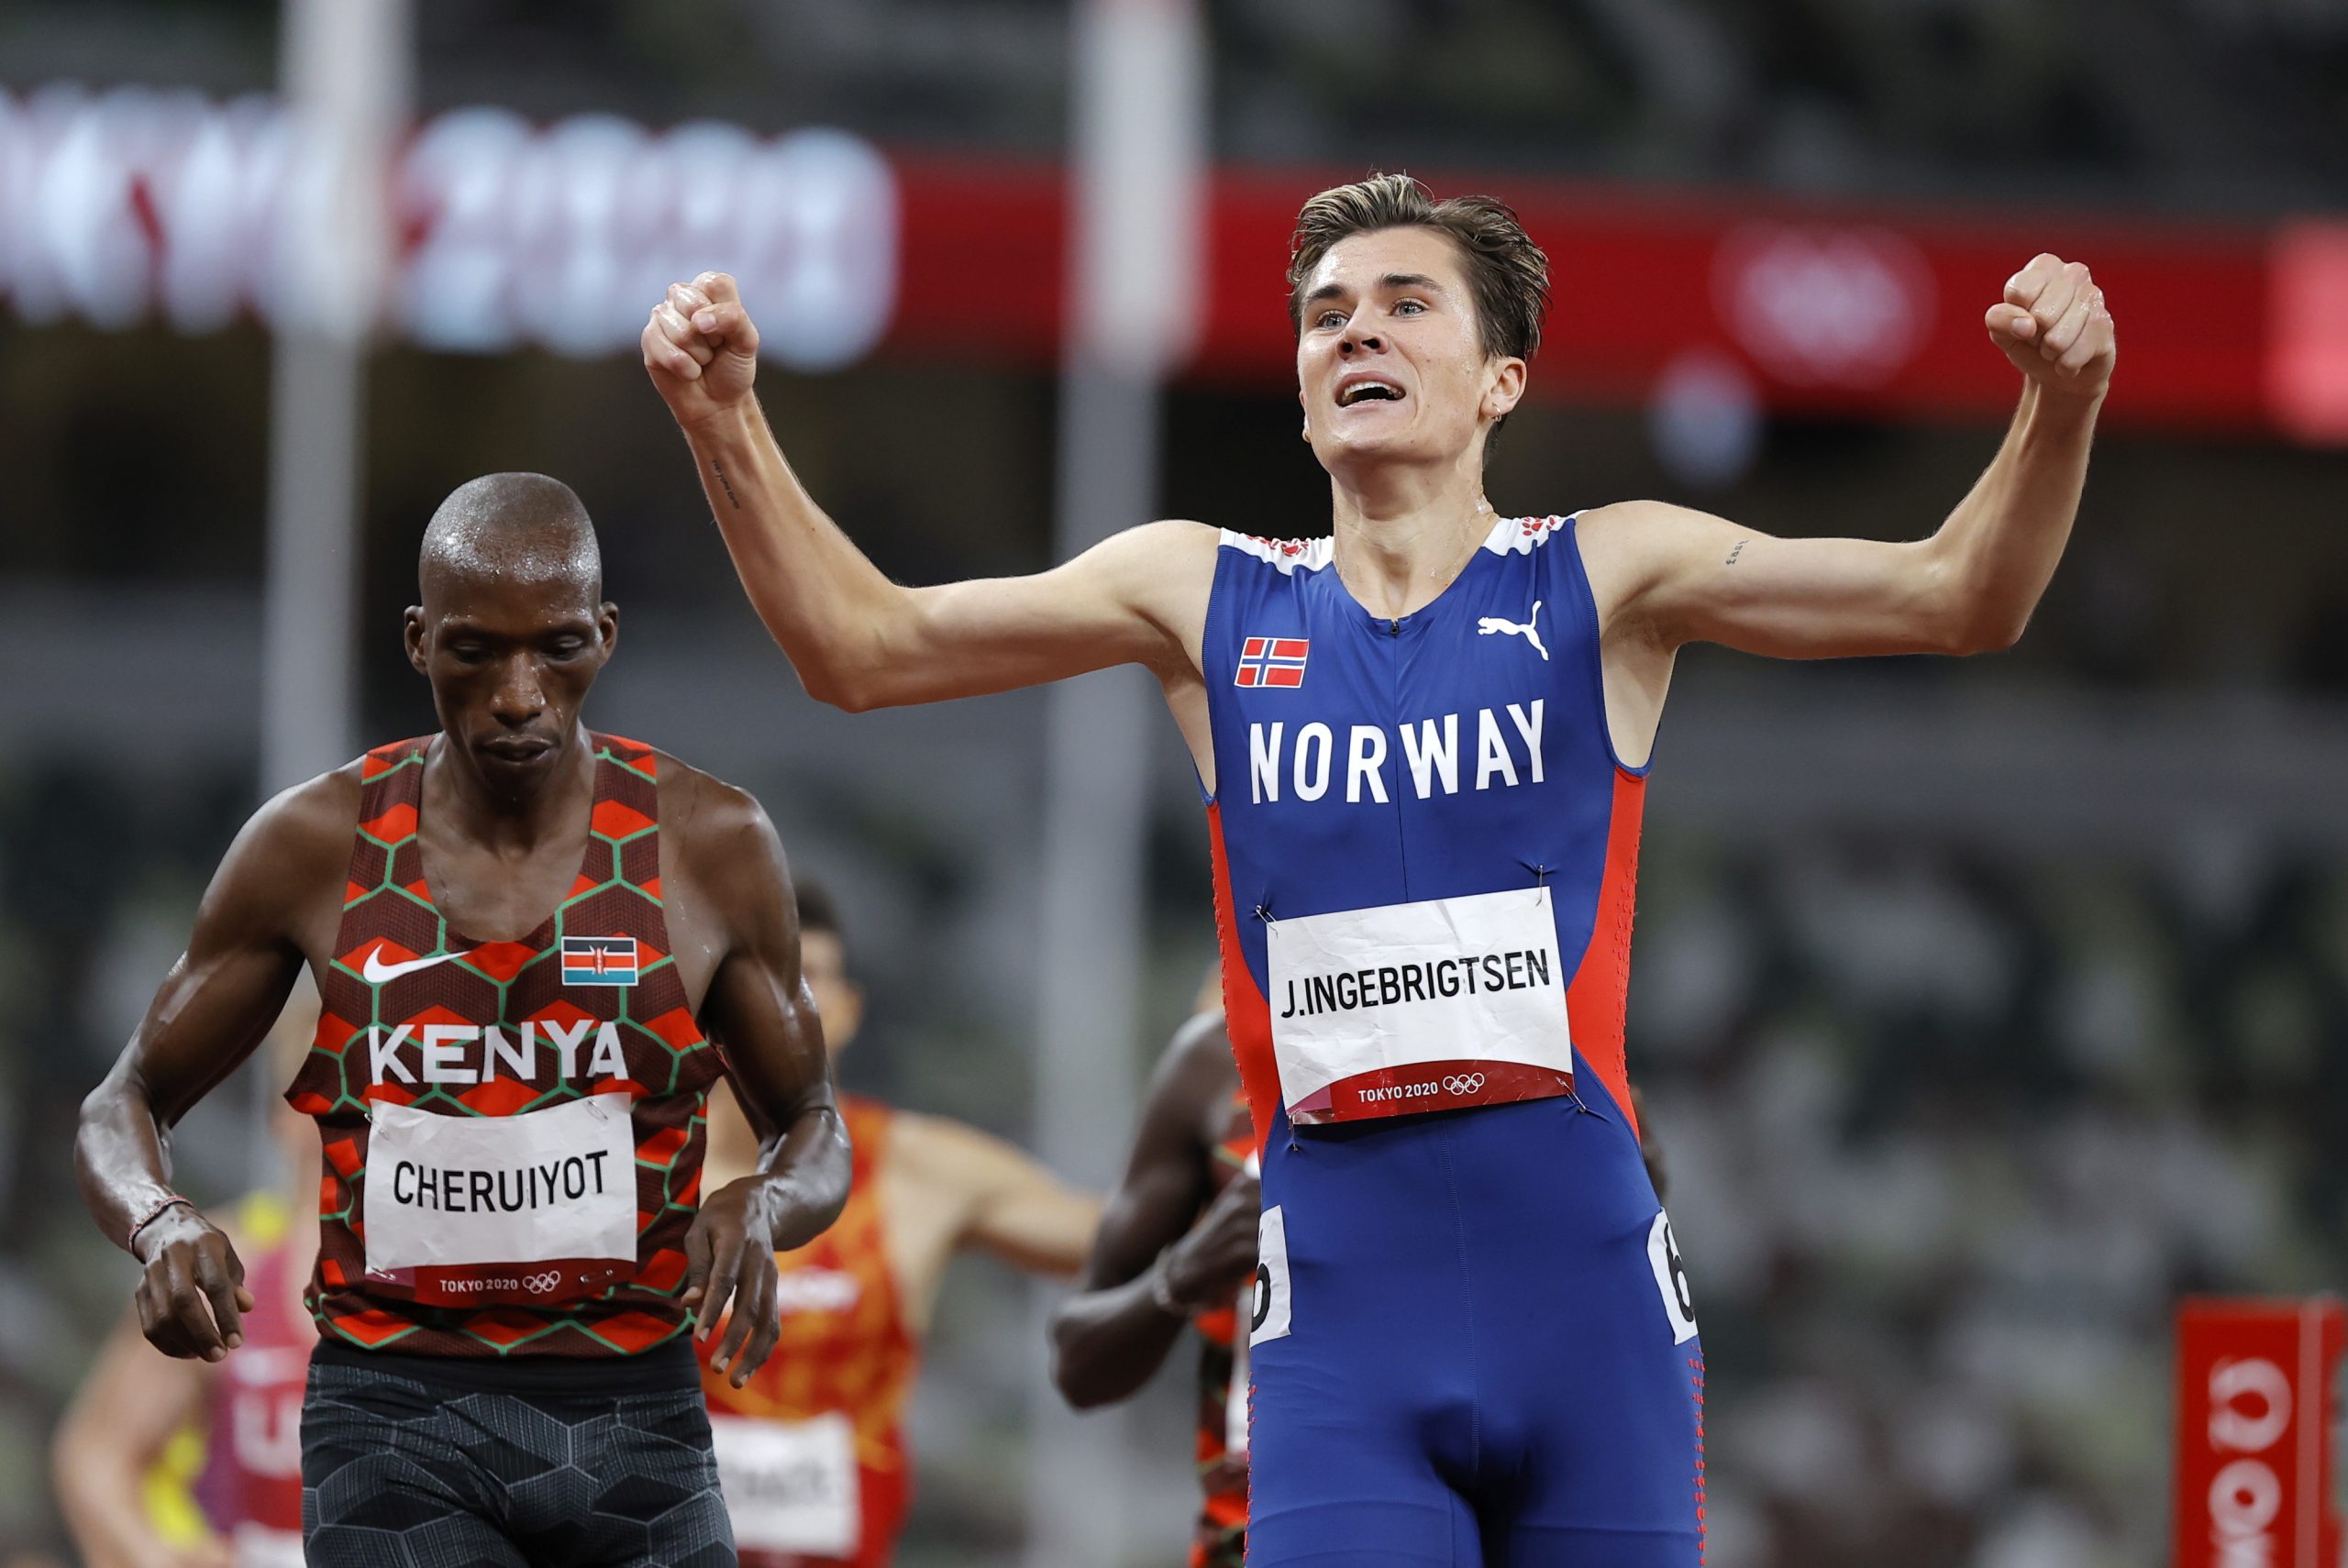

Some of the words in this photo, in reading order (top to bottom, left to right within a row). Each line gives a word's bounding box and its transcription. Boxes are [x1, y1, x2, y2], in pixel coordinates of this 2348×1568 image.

[1249, 699, 1545, 804] NORWAY
[1281, 948, 1551, 1018] J.INGEBRIGTSEN
[368, 1019, 629, 1086] KENYA
[1357, 1086, 1402, 1103] TOKYO
[1404, 1082, 1438, 1098] 2020
[393, 1150, 608, 1212] CHERUIYOT
[439, 1279, 483, 1292] TOKYO
[485, 1278, 518, 1290] 2020
[1664, 1222, 1694, 1322] 6
